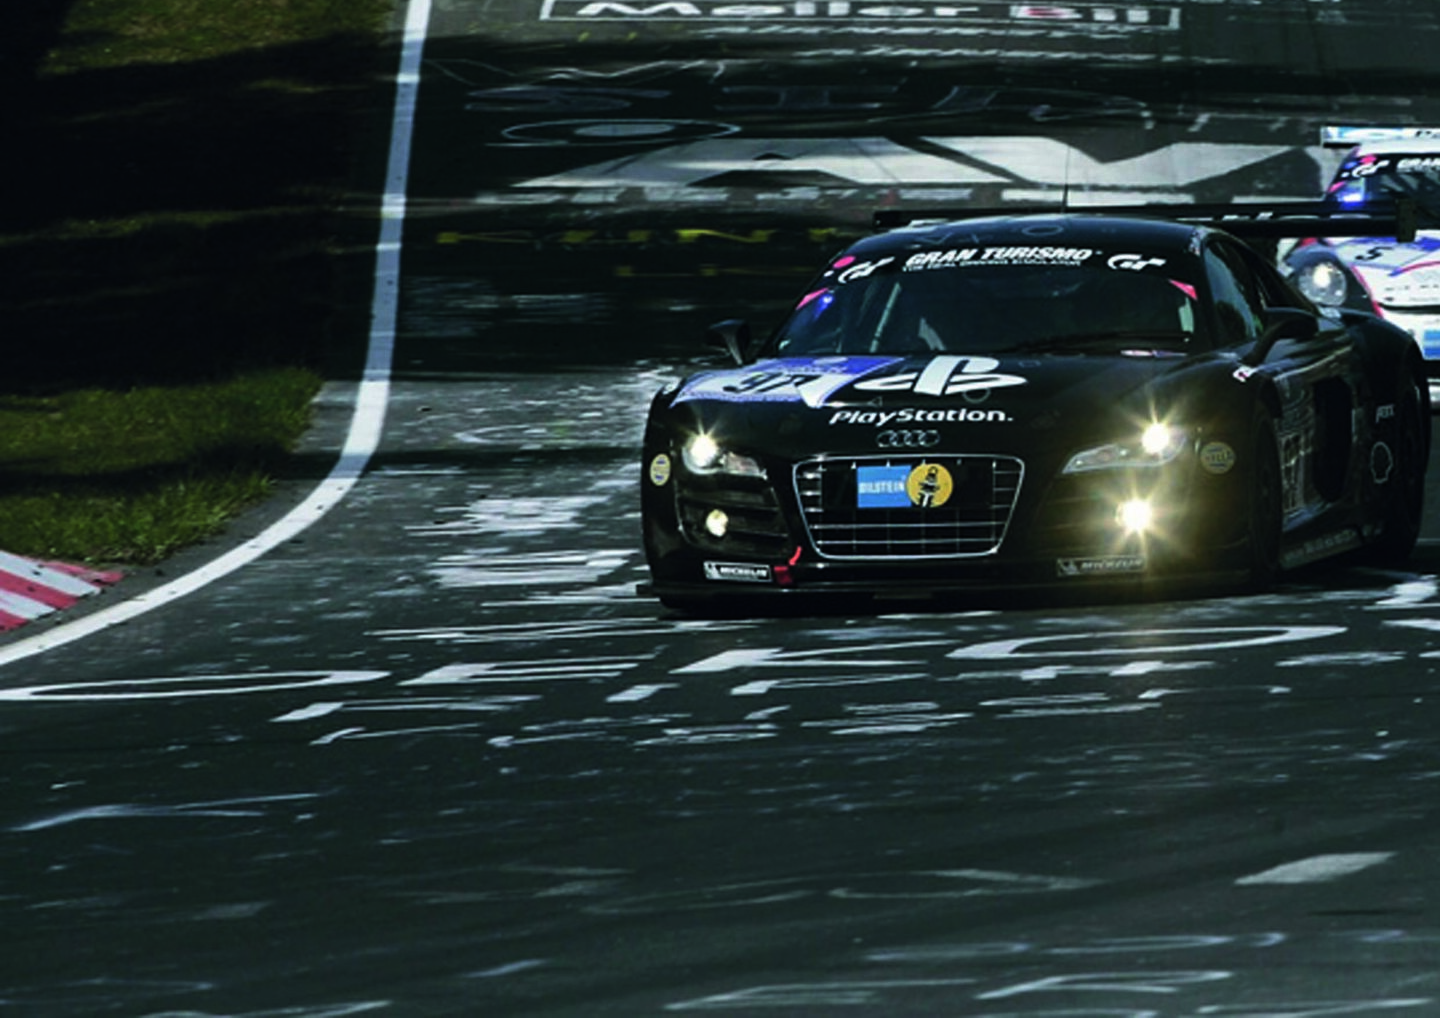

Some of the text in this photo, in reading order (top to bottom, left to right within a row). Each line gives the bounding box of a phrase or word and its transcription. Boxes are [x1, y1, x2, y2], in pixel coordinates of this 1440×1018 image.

[905, 246, 1093, 269] GRAN TURISMO
[829, 407, 1005, 427] PlayStation
